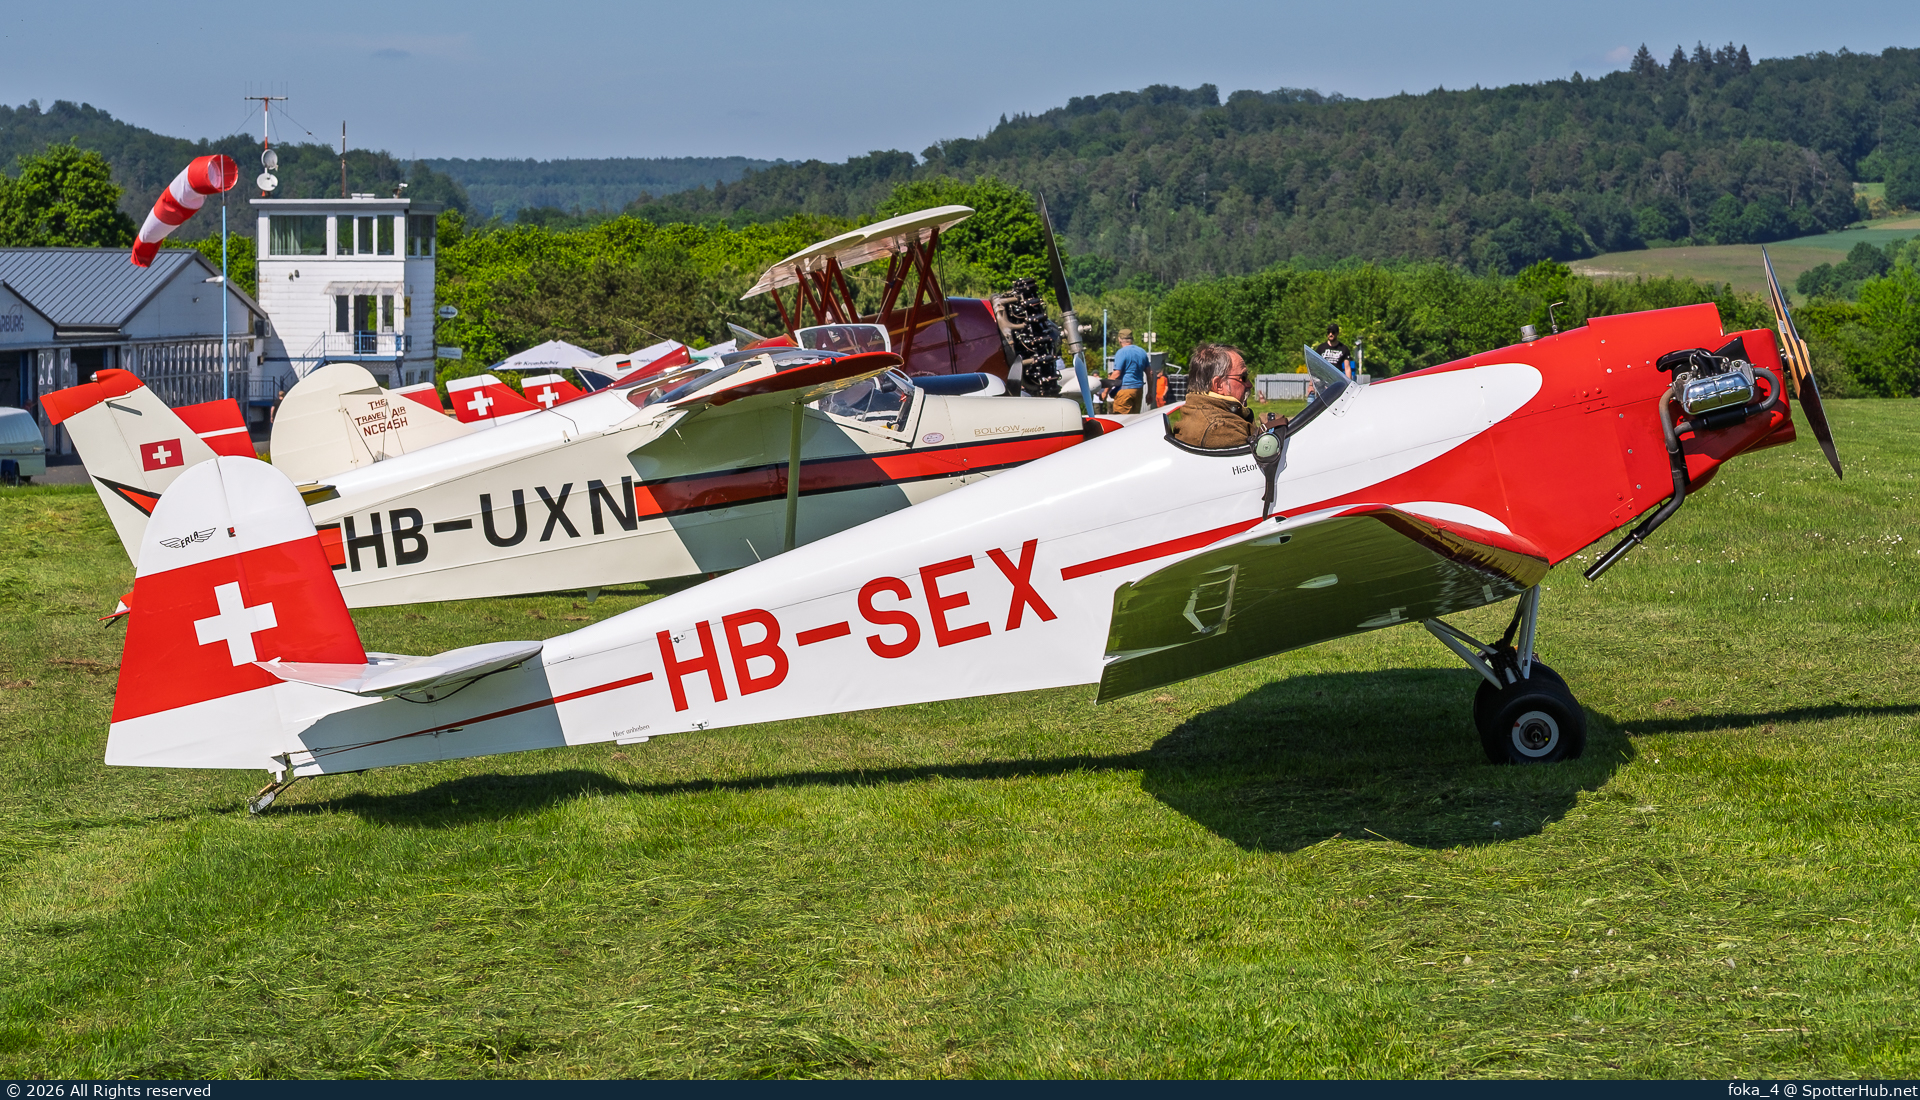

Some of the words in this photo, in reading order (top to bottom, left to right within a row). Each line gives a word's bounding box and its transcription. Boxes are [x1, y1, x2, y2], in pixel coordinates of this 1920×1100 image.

[368, 399, 386, 410] THE
[355, 412, 387, 426] TRAVEL
[392, 406, 406, 418] AIR
[974, 425, 1020, 436] BOLKOW
[344, 476, 638, 572] HB-UXN
[181, 531, 199, 548] ERLA
[656, 538, 1058, 712] HB-SEX
